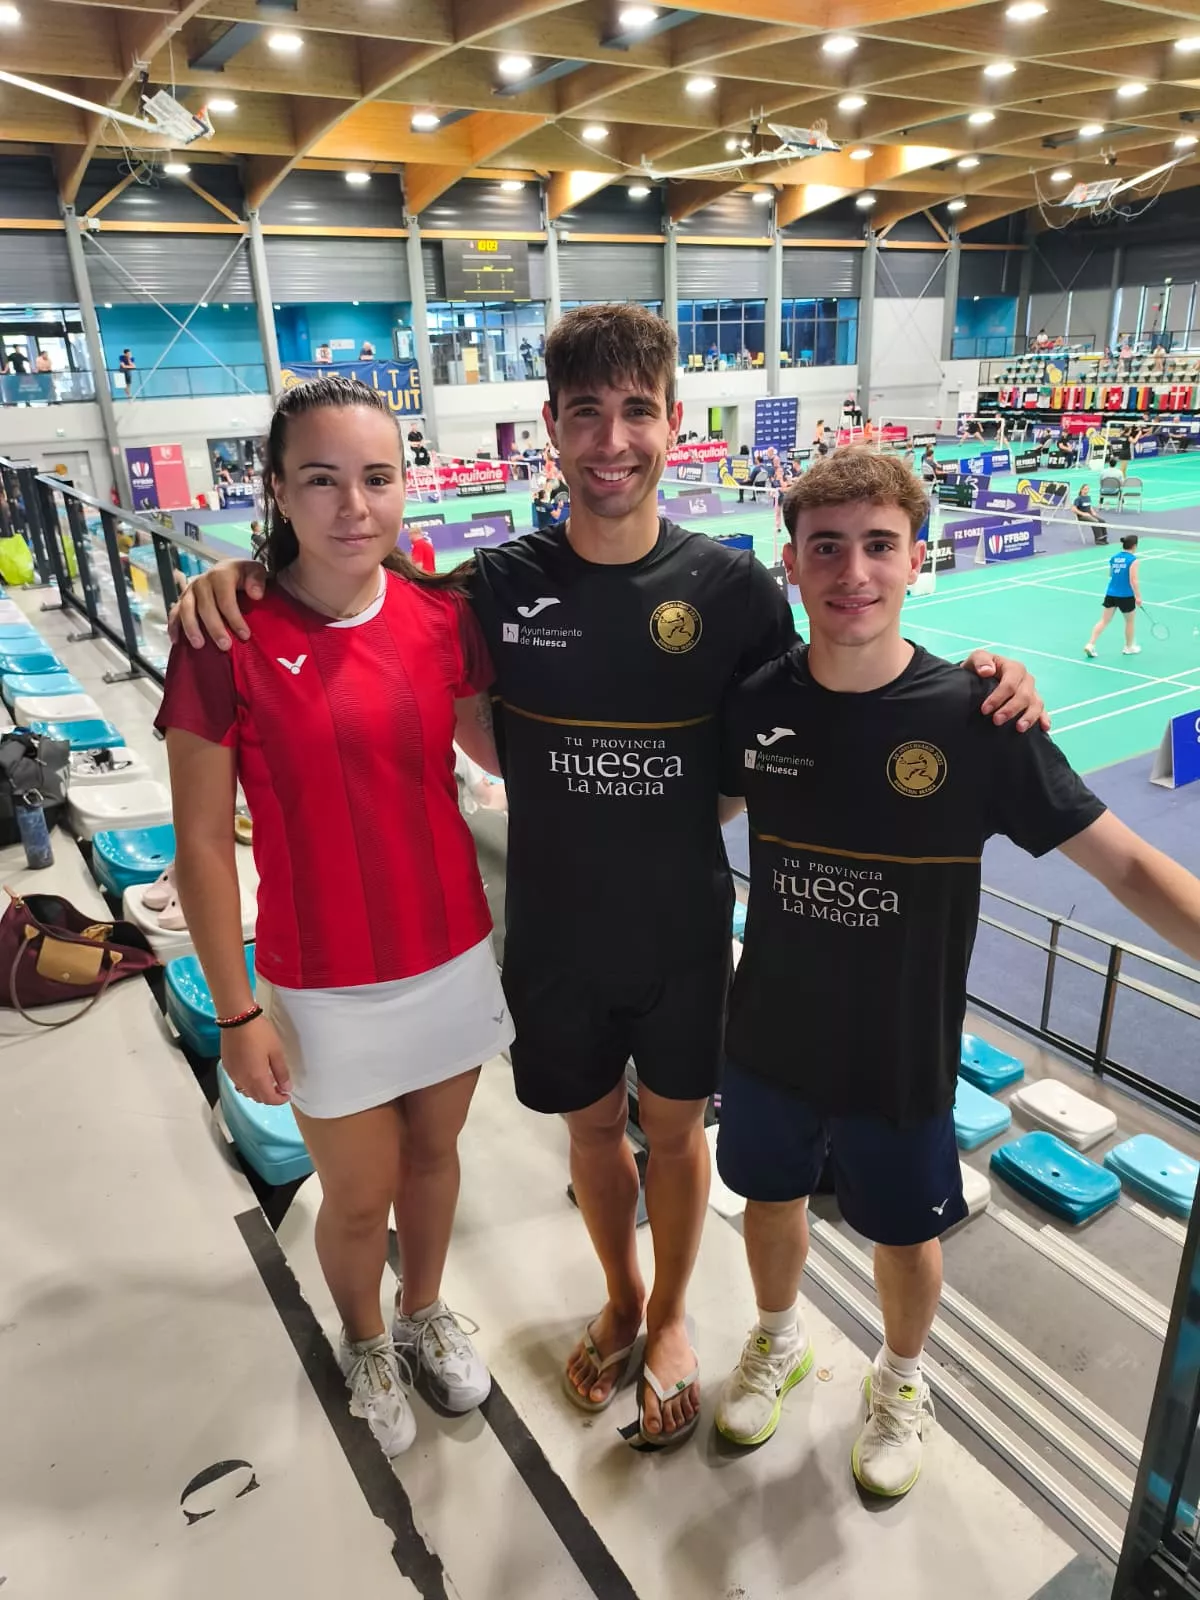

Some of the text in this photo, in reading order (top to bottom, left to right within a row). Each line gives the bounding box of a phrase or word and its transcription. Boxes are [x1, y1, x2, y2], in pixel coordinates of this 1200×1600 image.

[520, 625, 583, 637] Ayuntamiento
[520, 636, 567, 648] de Huesca
[757, 750, 815, 767] Ayuntamiento
[766, 763, 798, 776] Huesca
